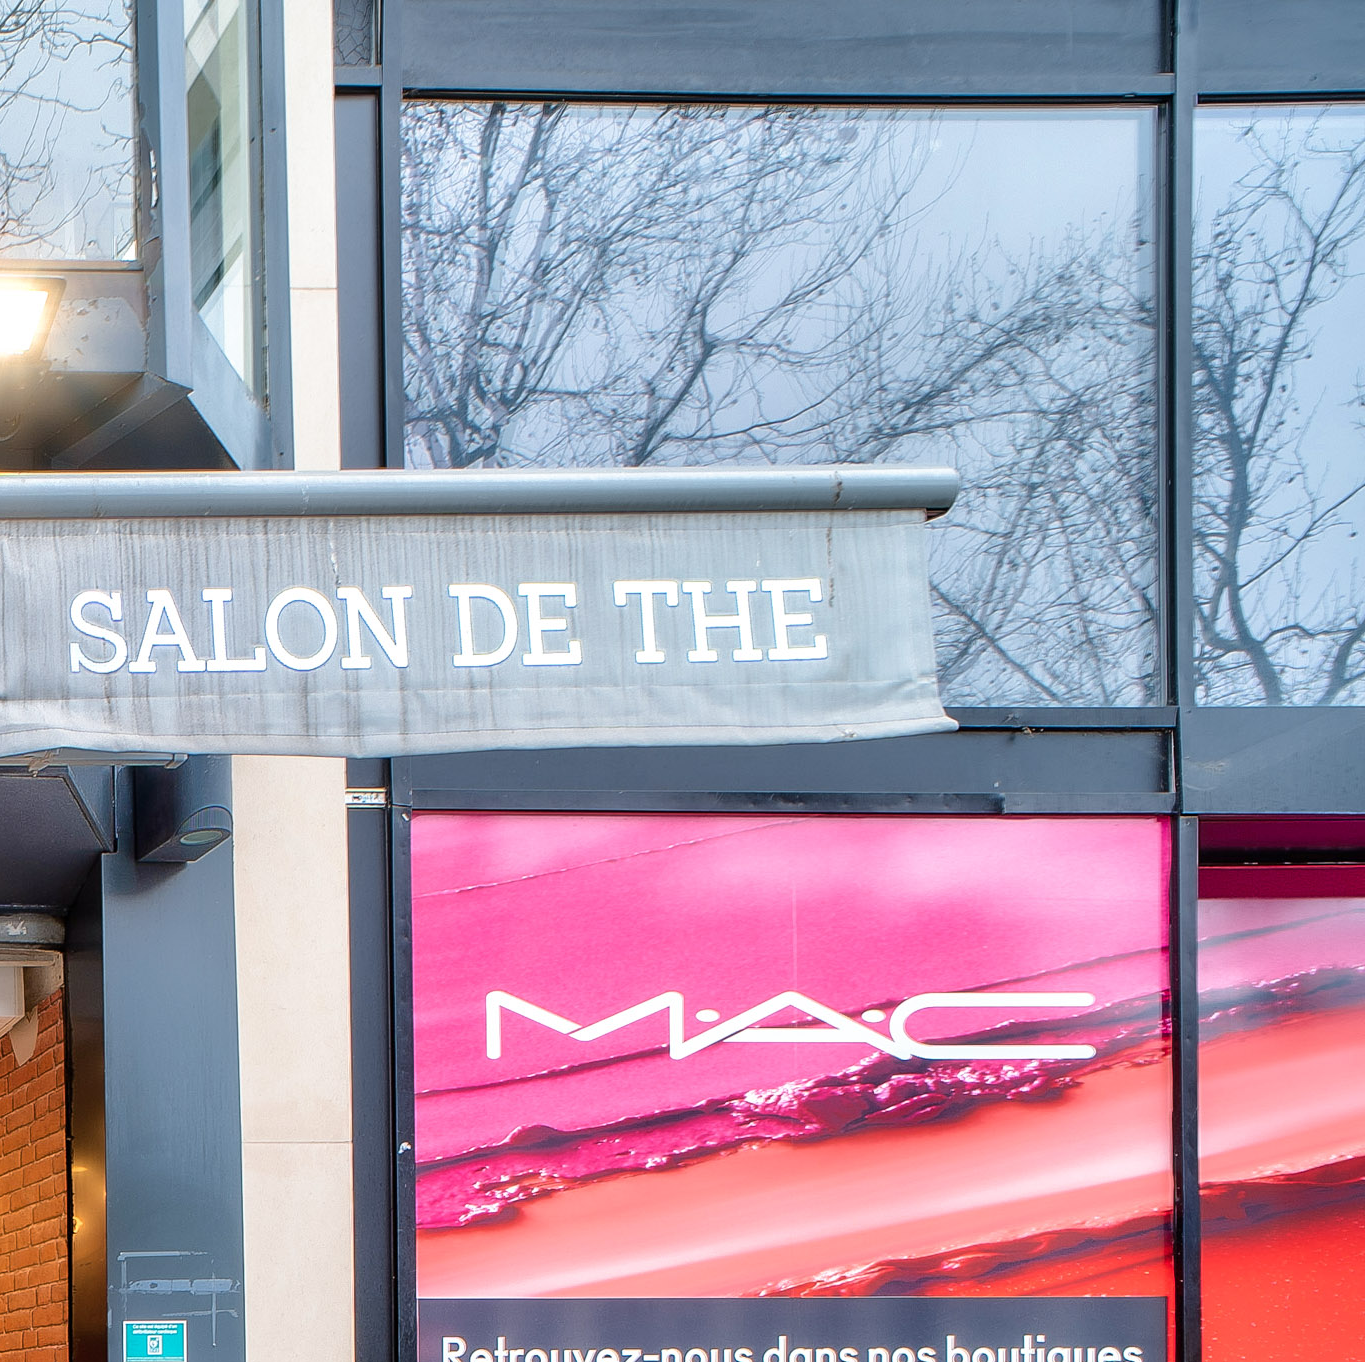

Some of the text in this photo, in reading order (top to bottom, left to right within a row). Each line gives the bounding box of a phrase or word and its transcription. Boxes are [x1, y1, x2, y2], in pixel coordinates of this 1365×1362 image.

[69, 577, 828, 675] SALON DE THE
